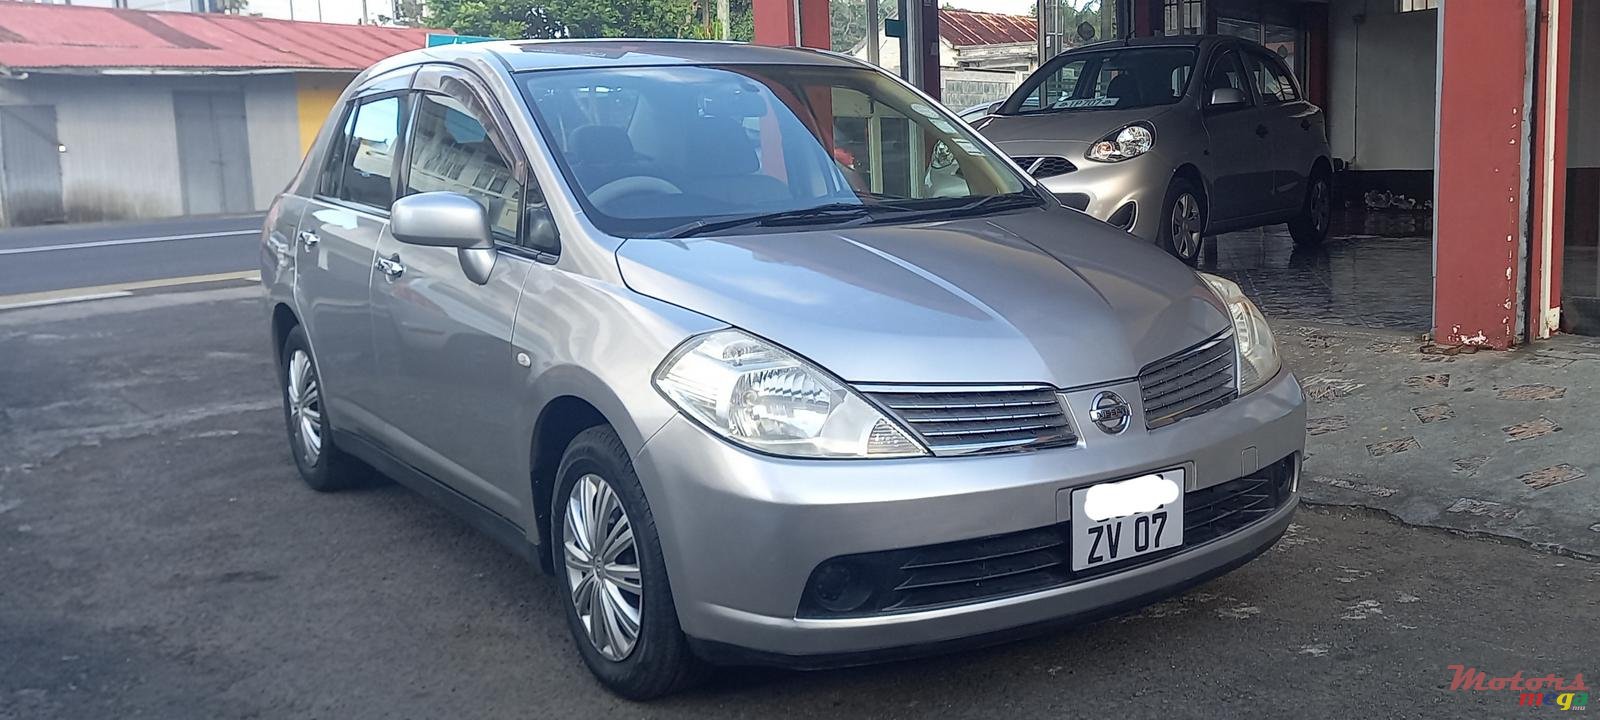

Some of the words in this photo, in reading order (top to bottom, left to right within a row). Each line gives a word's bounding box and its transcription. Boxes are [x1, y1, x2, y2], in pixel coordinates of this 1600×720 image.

[1096, 405, 1128, 420] NISSAN
[1087, 521, 1122, 565] ZV
[1134, 511, 1168, 553] 07
